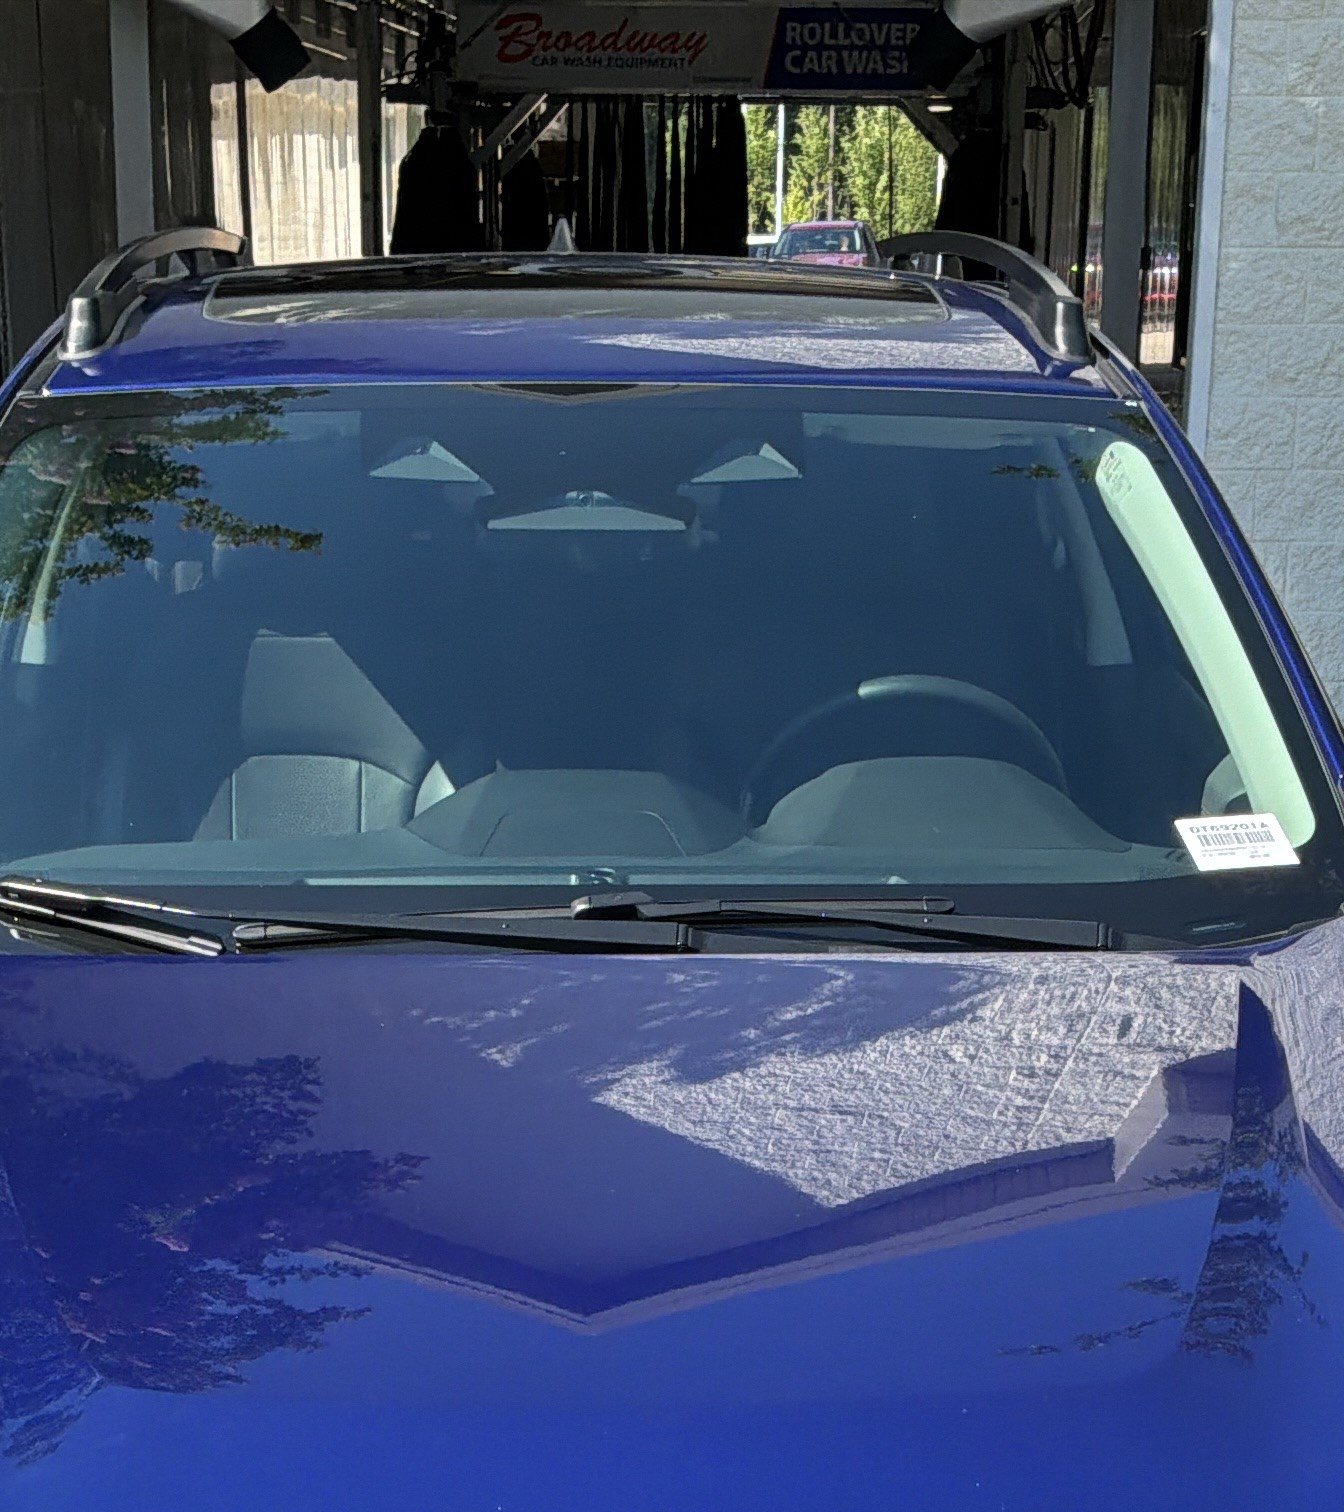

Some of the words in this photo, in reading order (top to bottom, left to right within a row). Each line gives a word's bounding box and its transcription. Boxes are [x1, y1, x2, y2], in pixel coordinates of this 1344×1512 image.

[494, 12, 708, 65] Broadway
[531, 56, 558, 67] CAR
[563, 56, 603, 68] WASH
[607, 56, 685, 69] EQUIPMENT
[785, 50, 837, 74] CAR
